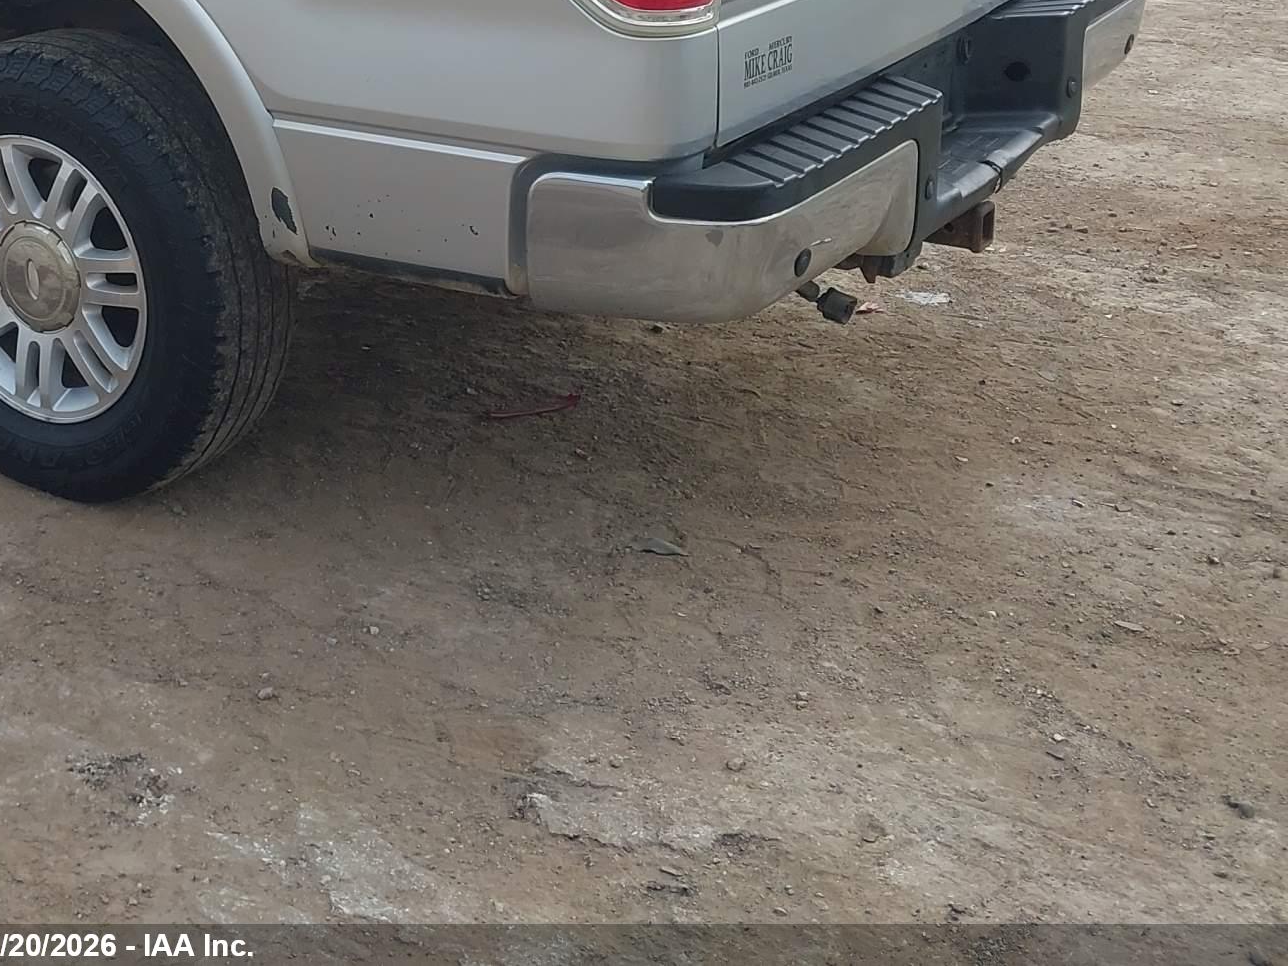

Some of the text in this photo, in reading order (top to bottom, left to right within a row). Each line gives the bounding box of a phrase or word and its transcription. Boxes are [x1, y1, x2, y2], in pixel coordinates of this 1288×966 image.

[744, 47, 760, 60] FORD
[744, 43, 793, 81] MIKE CRAIG
